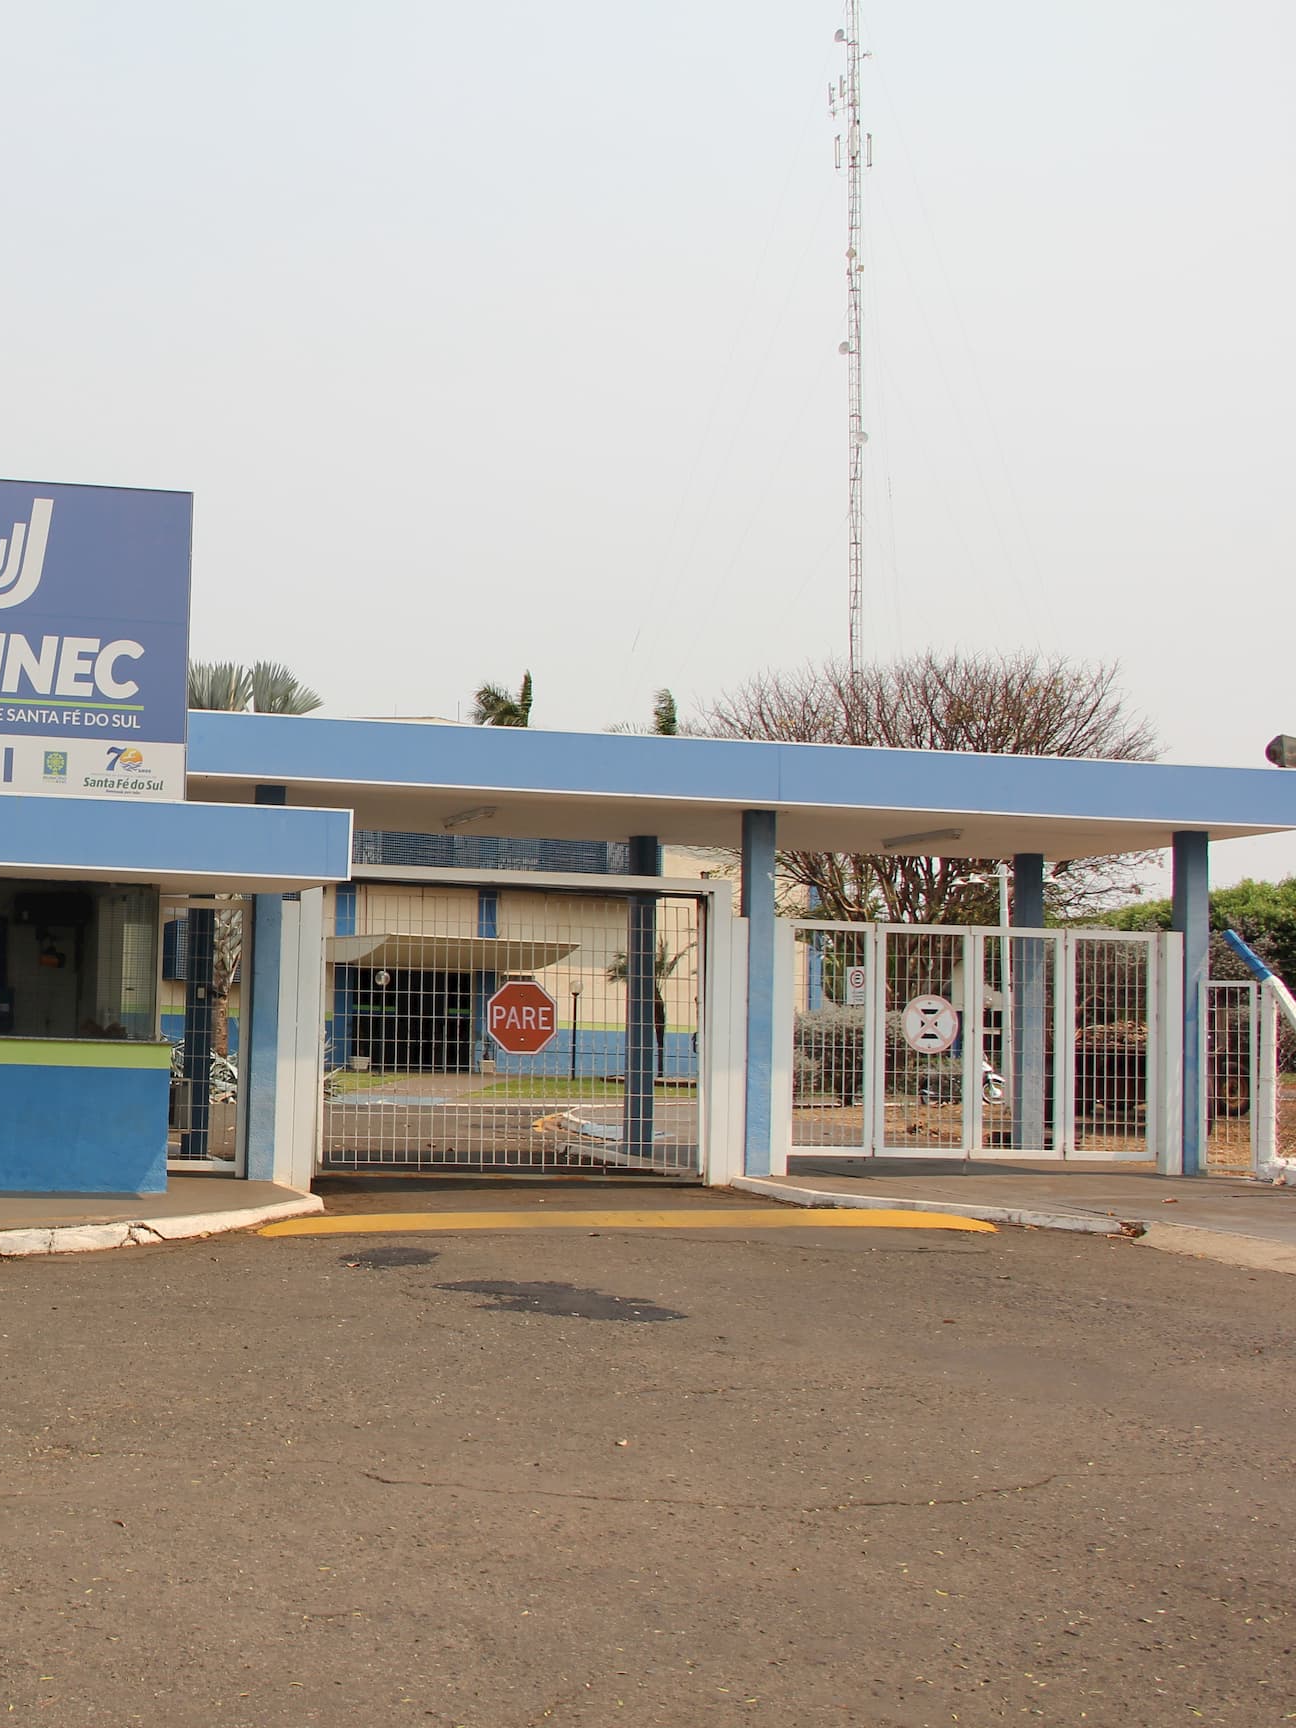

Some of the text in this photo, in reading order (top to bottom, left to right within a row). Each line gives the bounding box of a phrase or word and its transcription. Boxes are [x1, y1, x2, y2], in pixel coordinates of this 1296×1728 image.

[7, 709, 59, 724] SANTA
[62, 709, 81, 725] FÉ
[84, 712, 109, 726] DO
[111, 714, 141, 729] SUL
[83, 776, 164, 791] Santa Fé do Sul
[493, 1005, 552, 1031] PARE
